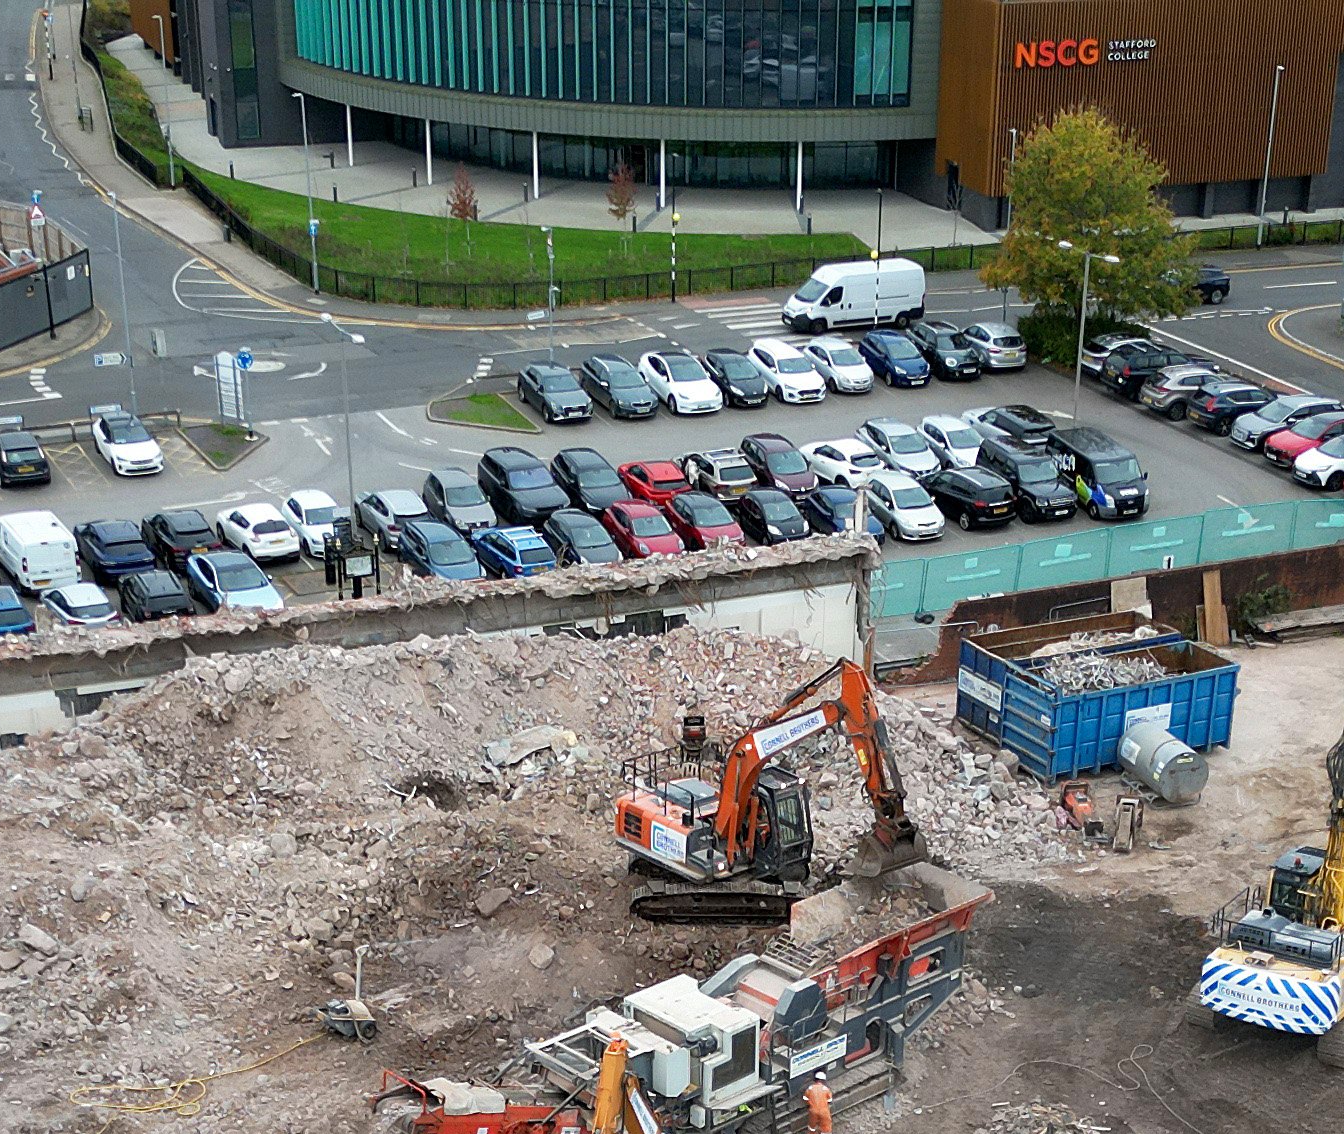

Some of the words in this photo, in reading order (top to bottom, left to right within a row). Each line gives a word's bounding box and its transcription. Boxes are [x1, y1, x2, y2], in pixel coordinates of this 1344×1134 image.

[1015, 38, 1099, 69] NSCG
[1108, 38, 1157, 51] STAFFORD
[1107, 50, 1150, 62] COLLEGE
[1219, 985, 1255, 1005] CONNELL
[1256, 997, 1301, 1013] BROTHERS
